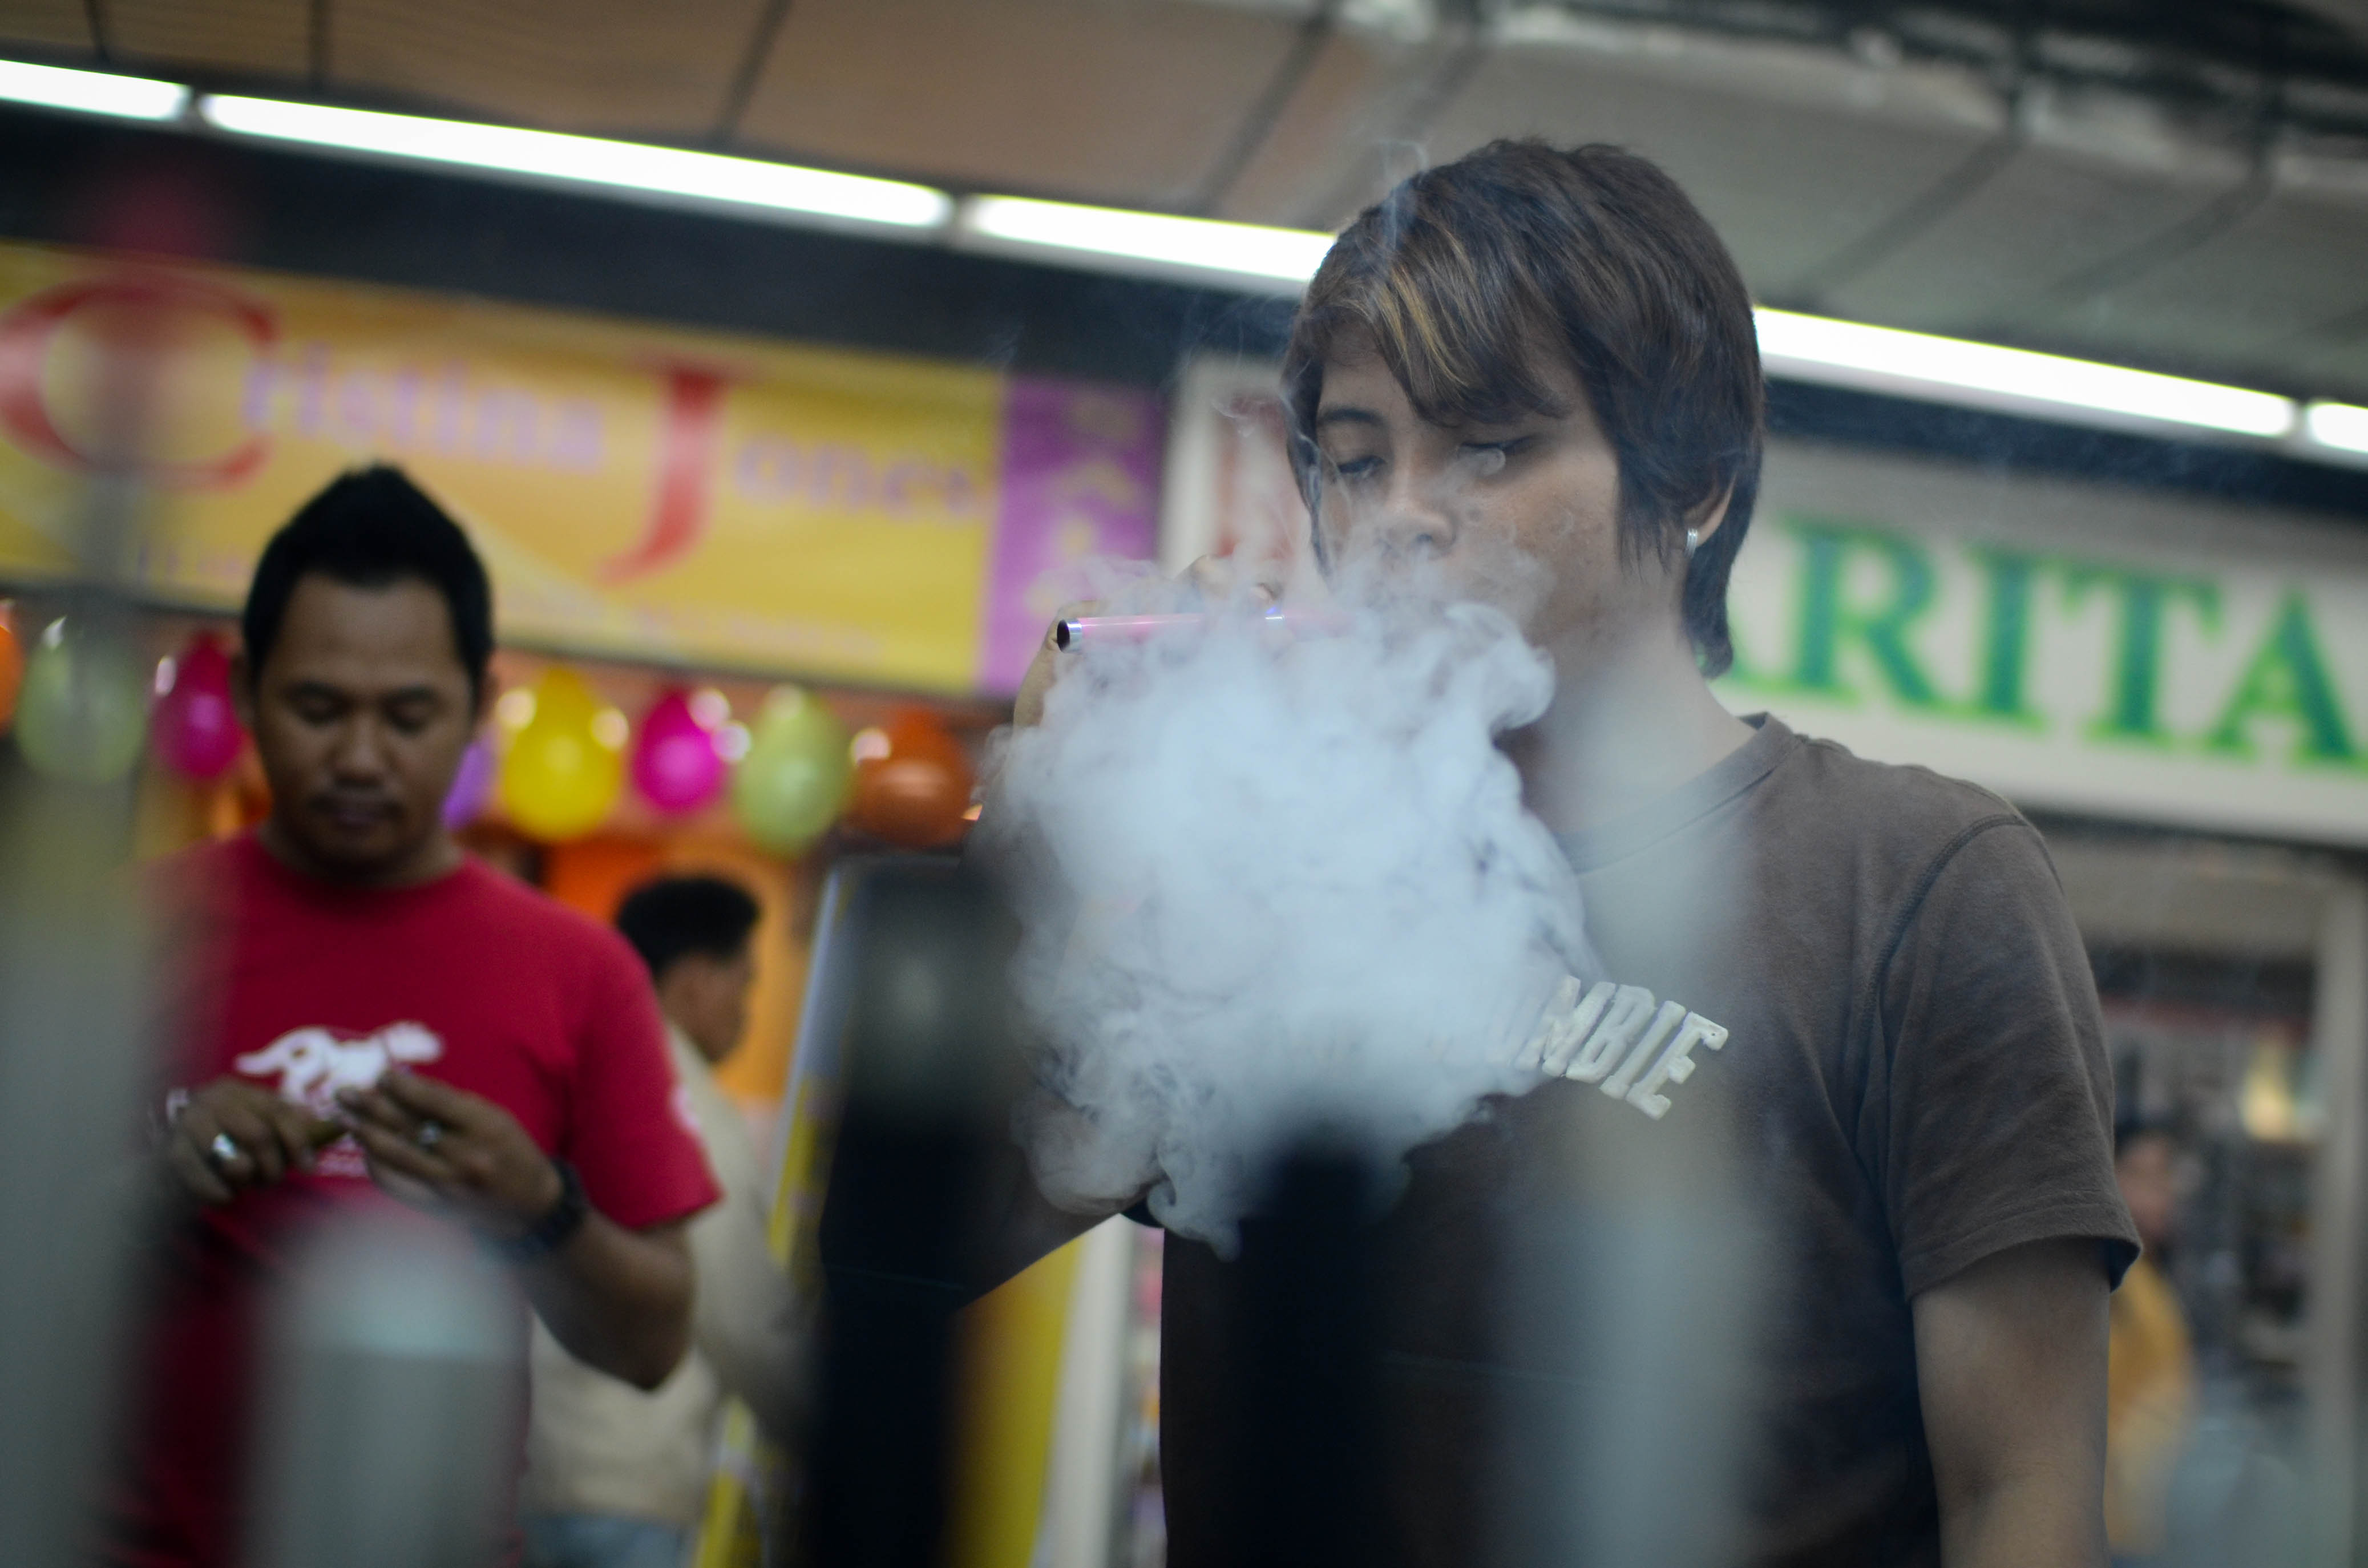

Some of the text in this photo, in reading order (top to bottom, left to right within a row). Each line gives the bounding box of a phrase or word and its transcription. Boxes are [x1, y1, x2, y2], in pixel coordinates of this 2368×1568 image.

[0, 271, 604, 493] Cristina
[593, 354, 983, 589] Jones
[1489, 973, 1729, 1120] MBIE
